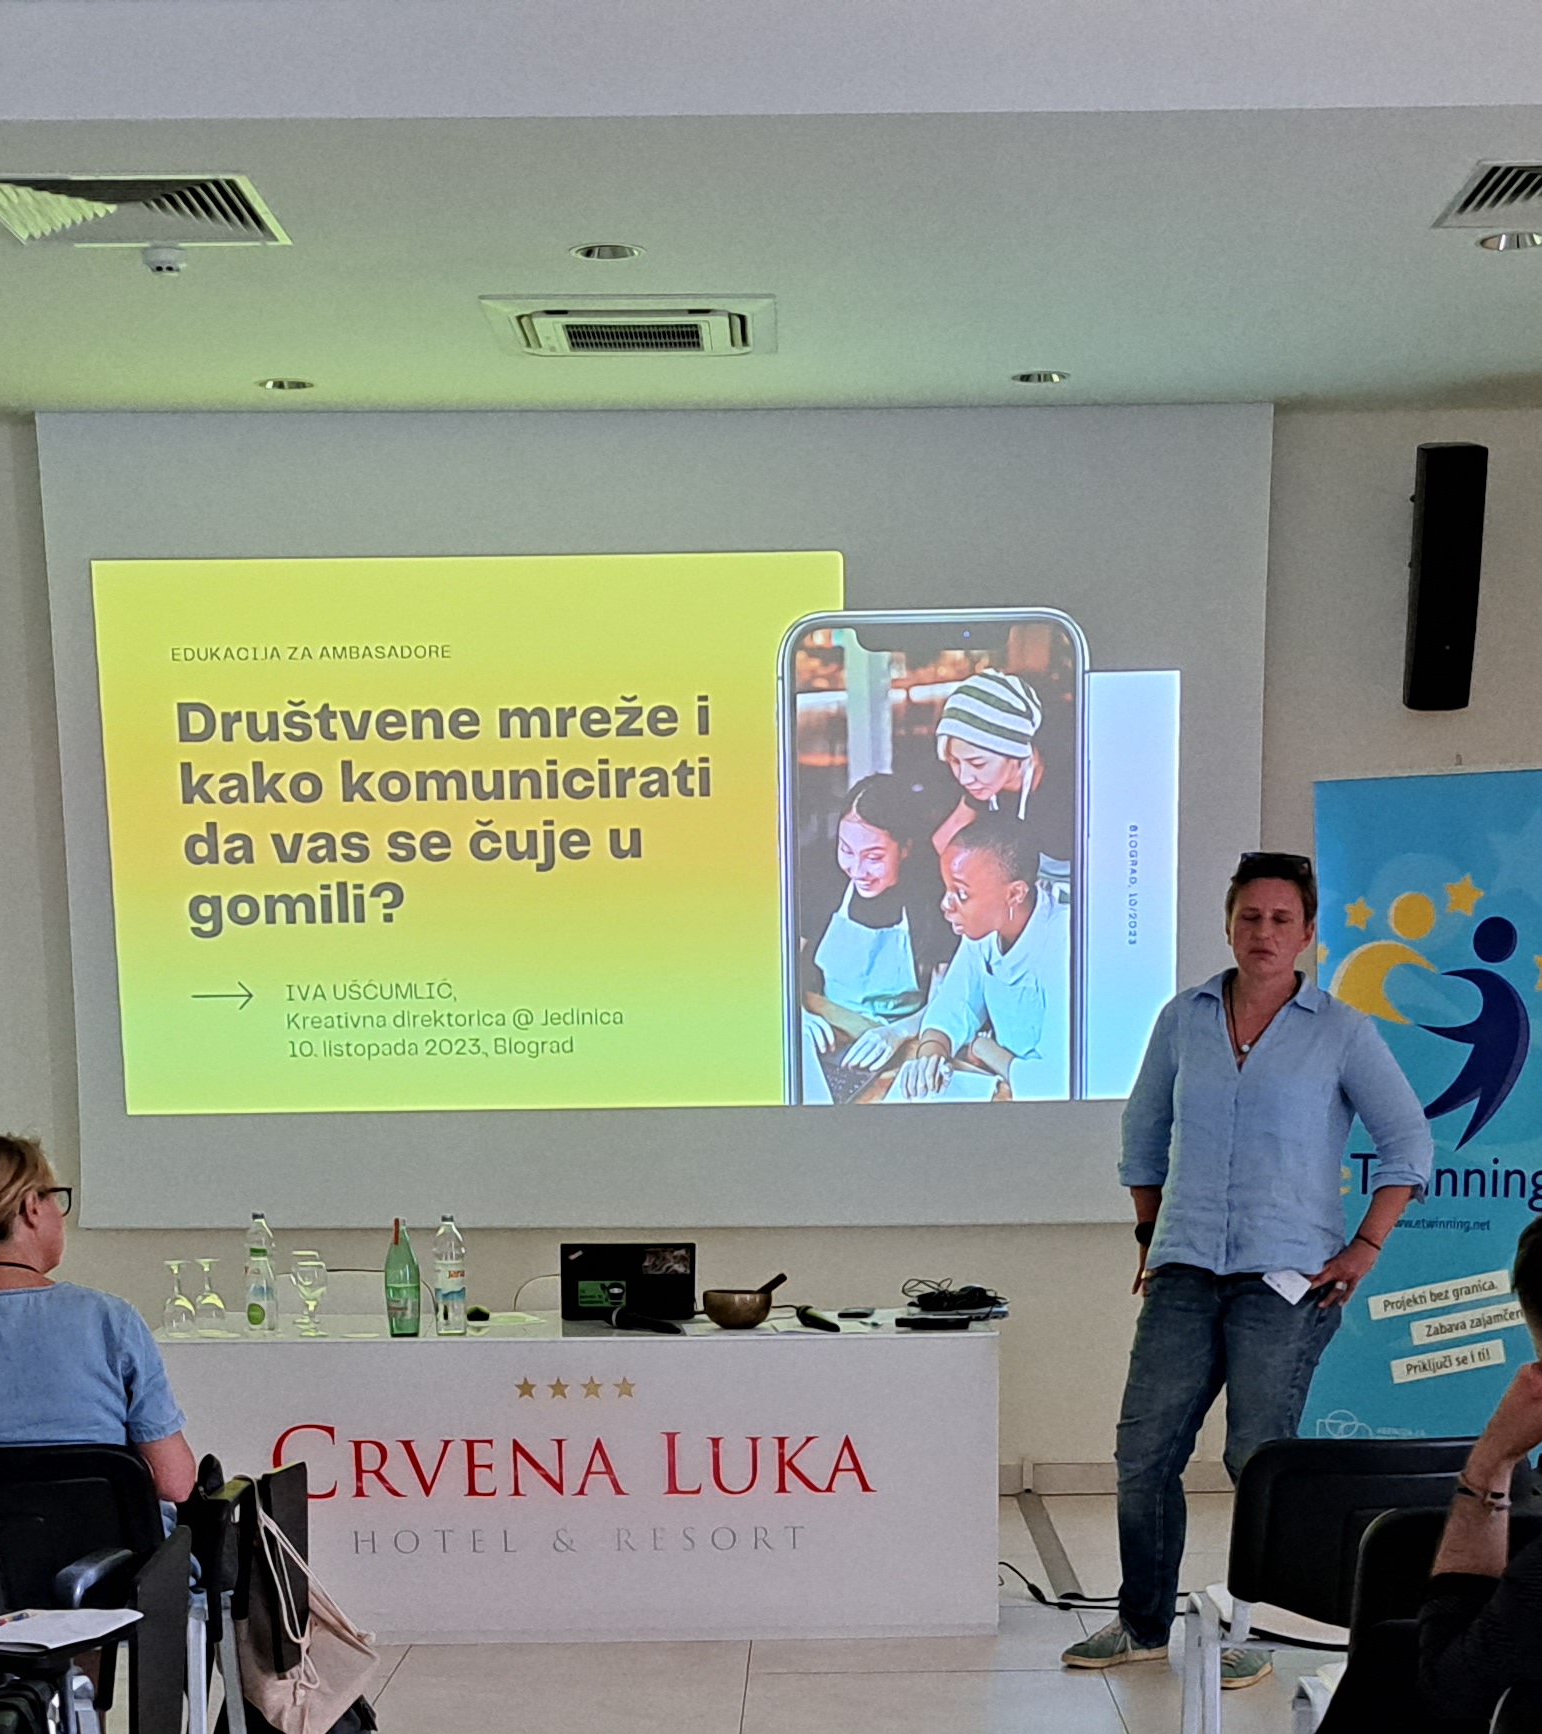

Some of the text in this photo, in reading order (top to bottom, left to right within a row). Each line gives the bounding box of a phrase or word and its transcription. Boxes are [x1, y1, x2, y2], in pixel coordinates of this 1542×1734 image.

[170, 644, 452, 662] EDUKACIJA ZA AMBASADORE
[176, 694, 711, 743] Društvene mreže i
[179, 757, 713, 805] kako komunicirati
[183, 818, 643, 873] da vas se čuje u
[187, 881, 405, 940] gomili?
[285, 978, 457, 1003] IVA UŠĆUMLIĆ,
[286, 1008, 624, 1031] Kreativna direktorica @ Jedinica
[288, 1040, 318, 1059] 10.
[322, 1038, 419, 1061] listopada
[493, 1036, 574, 1060] Biograd
[1393, 1217, 1491, 1232] ww.etwinning.net
[1382, 1279, 1498, 1312] Projekti bez granica.
[1424, 1308, 1525, 1338] Zabava zajamčen
[272, 1424, 877, 1500] CRVENA LUKA
[353, 1525, 806, 1555] HOTEL & RESORT
